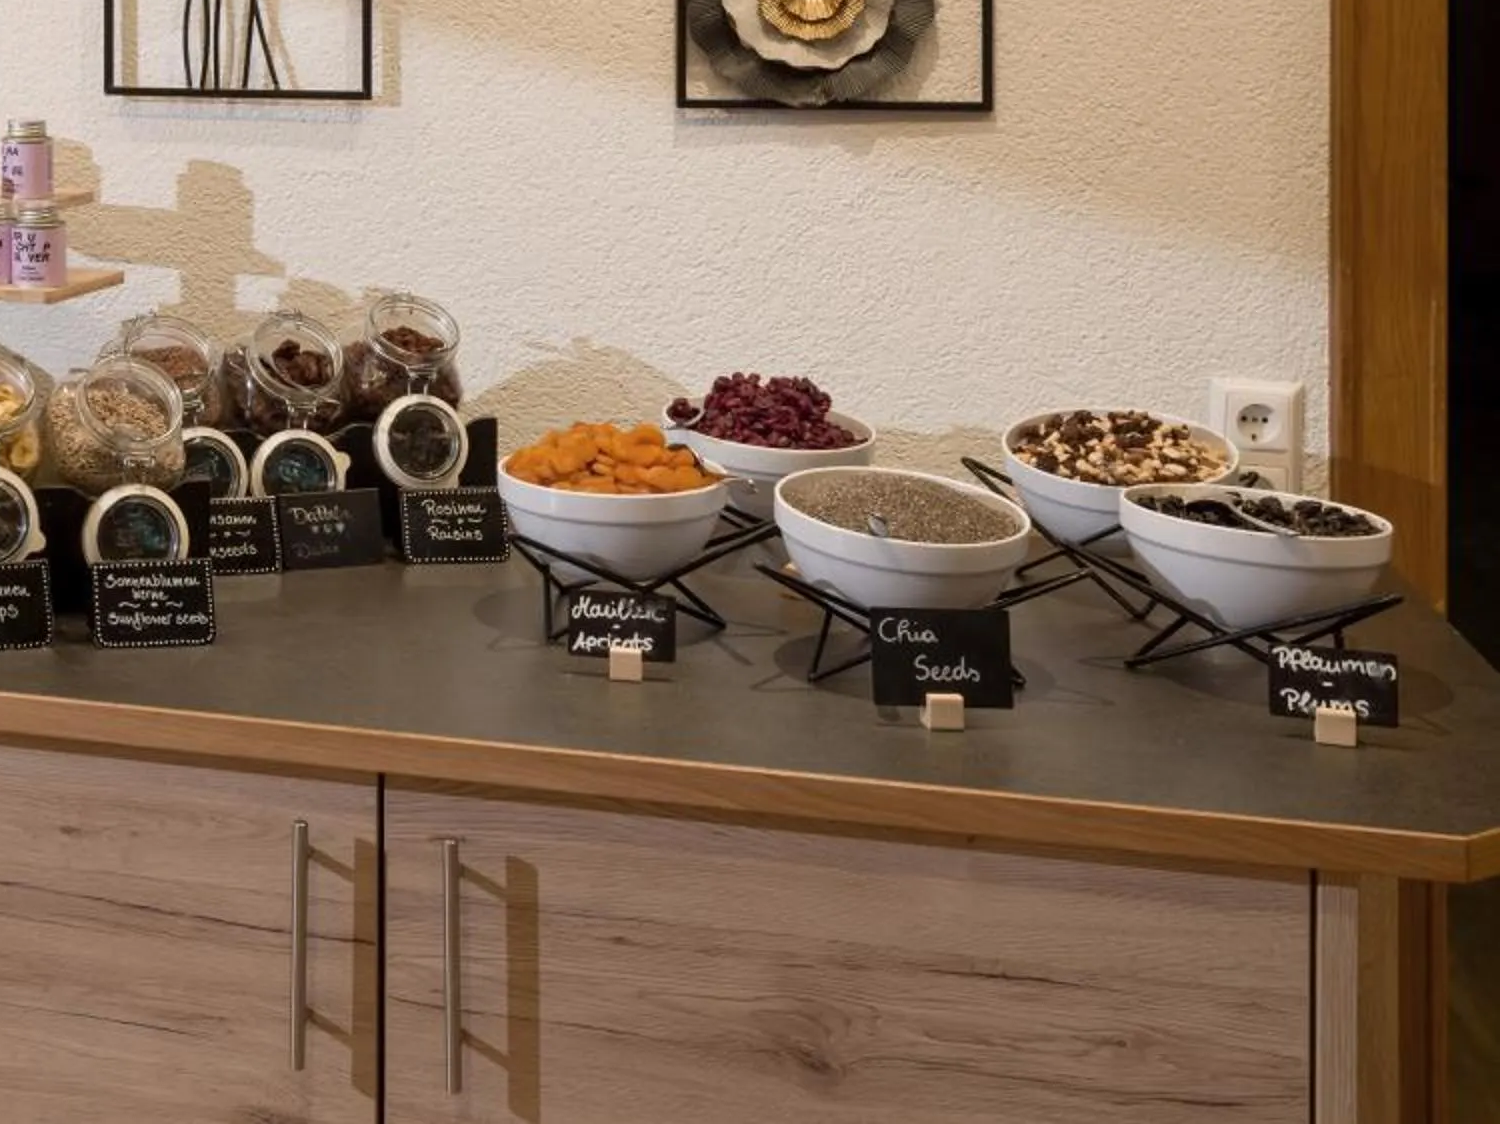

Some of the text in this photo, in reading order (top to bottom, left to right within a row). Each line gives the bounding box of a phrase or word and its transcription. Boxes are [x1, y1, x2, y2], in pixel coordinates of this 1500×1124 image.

[421, 499, 488, 516] Rosinen
[426, 525, 484, 541] Raisins
[878, 617, 940, 644] Chia
[913, 654, 981, 683] Seeds
[1271, 646, 1397, 681] Pflaumen
